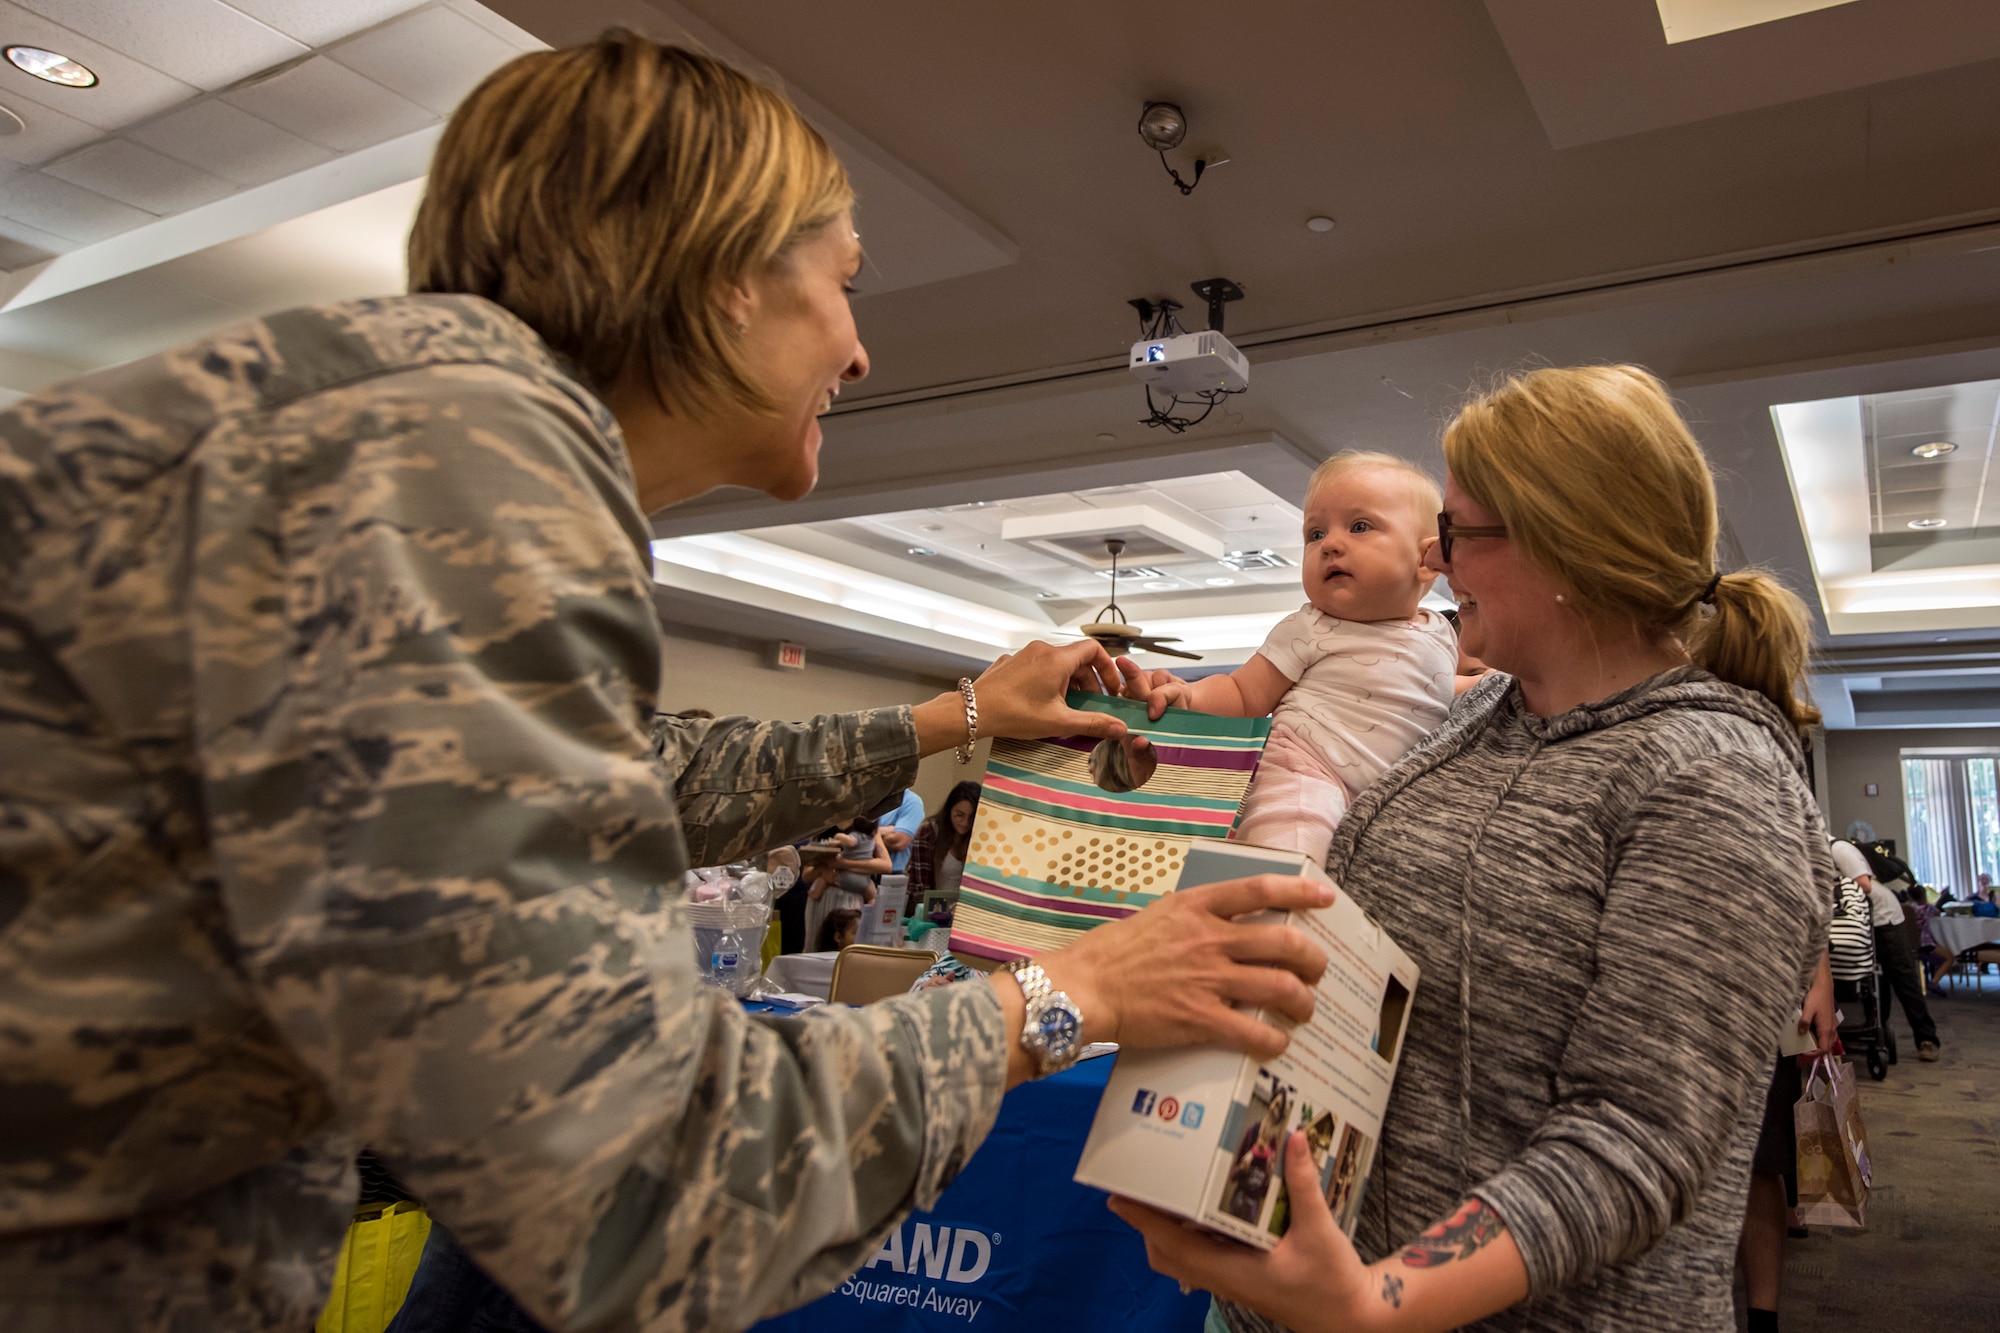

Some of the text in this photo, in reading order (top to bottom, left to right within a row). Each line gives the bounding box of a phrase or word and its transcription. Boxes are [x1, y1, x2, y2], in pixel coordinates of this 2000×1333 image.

[782, 645, 802, 665] EXIT
[841, 1273, 982, 1322] Squared Away
